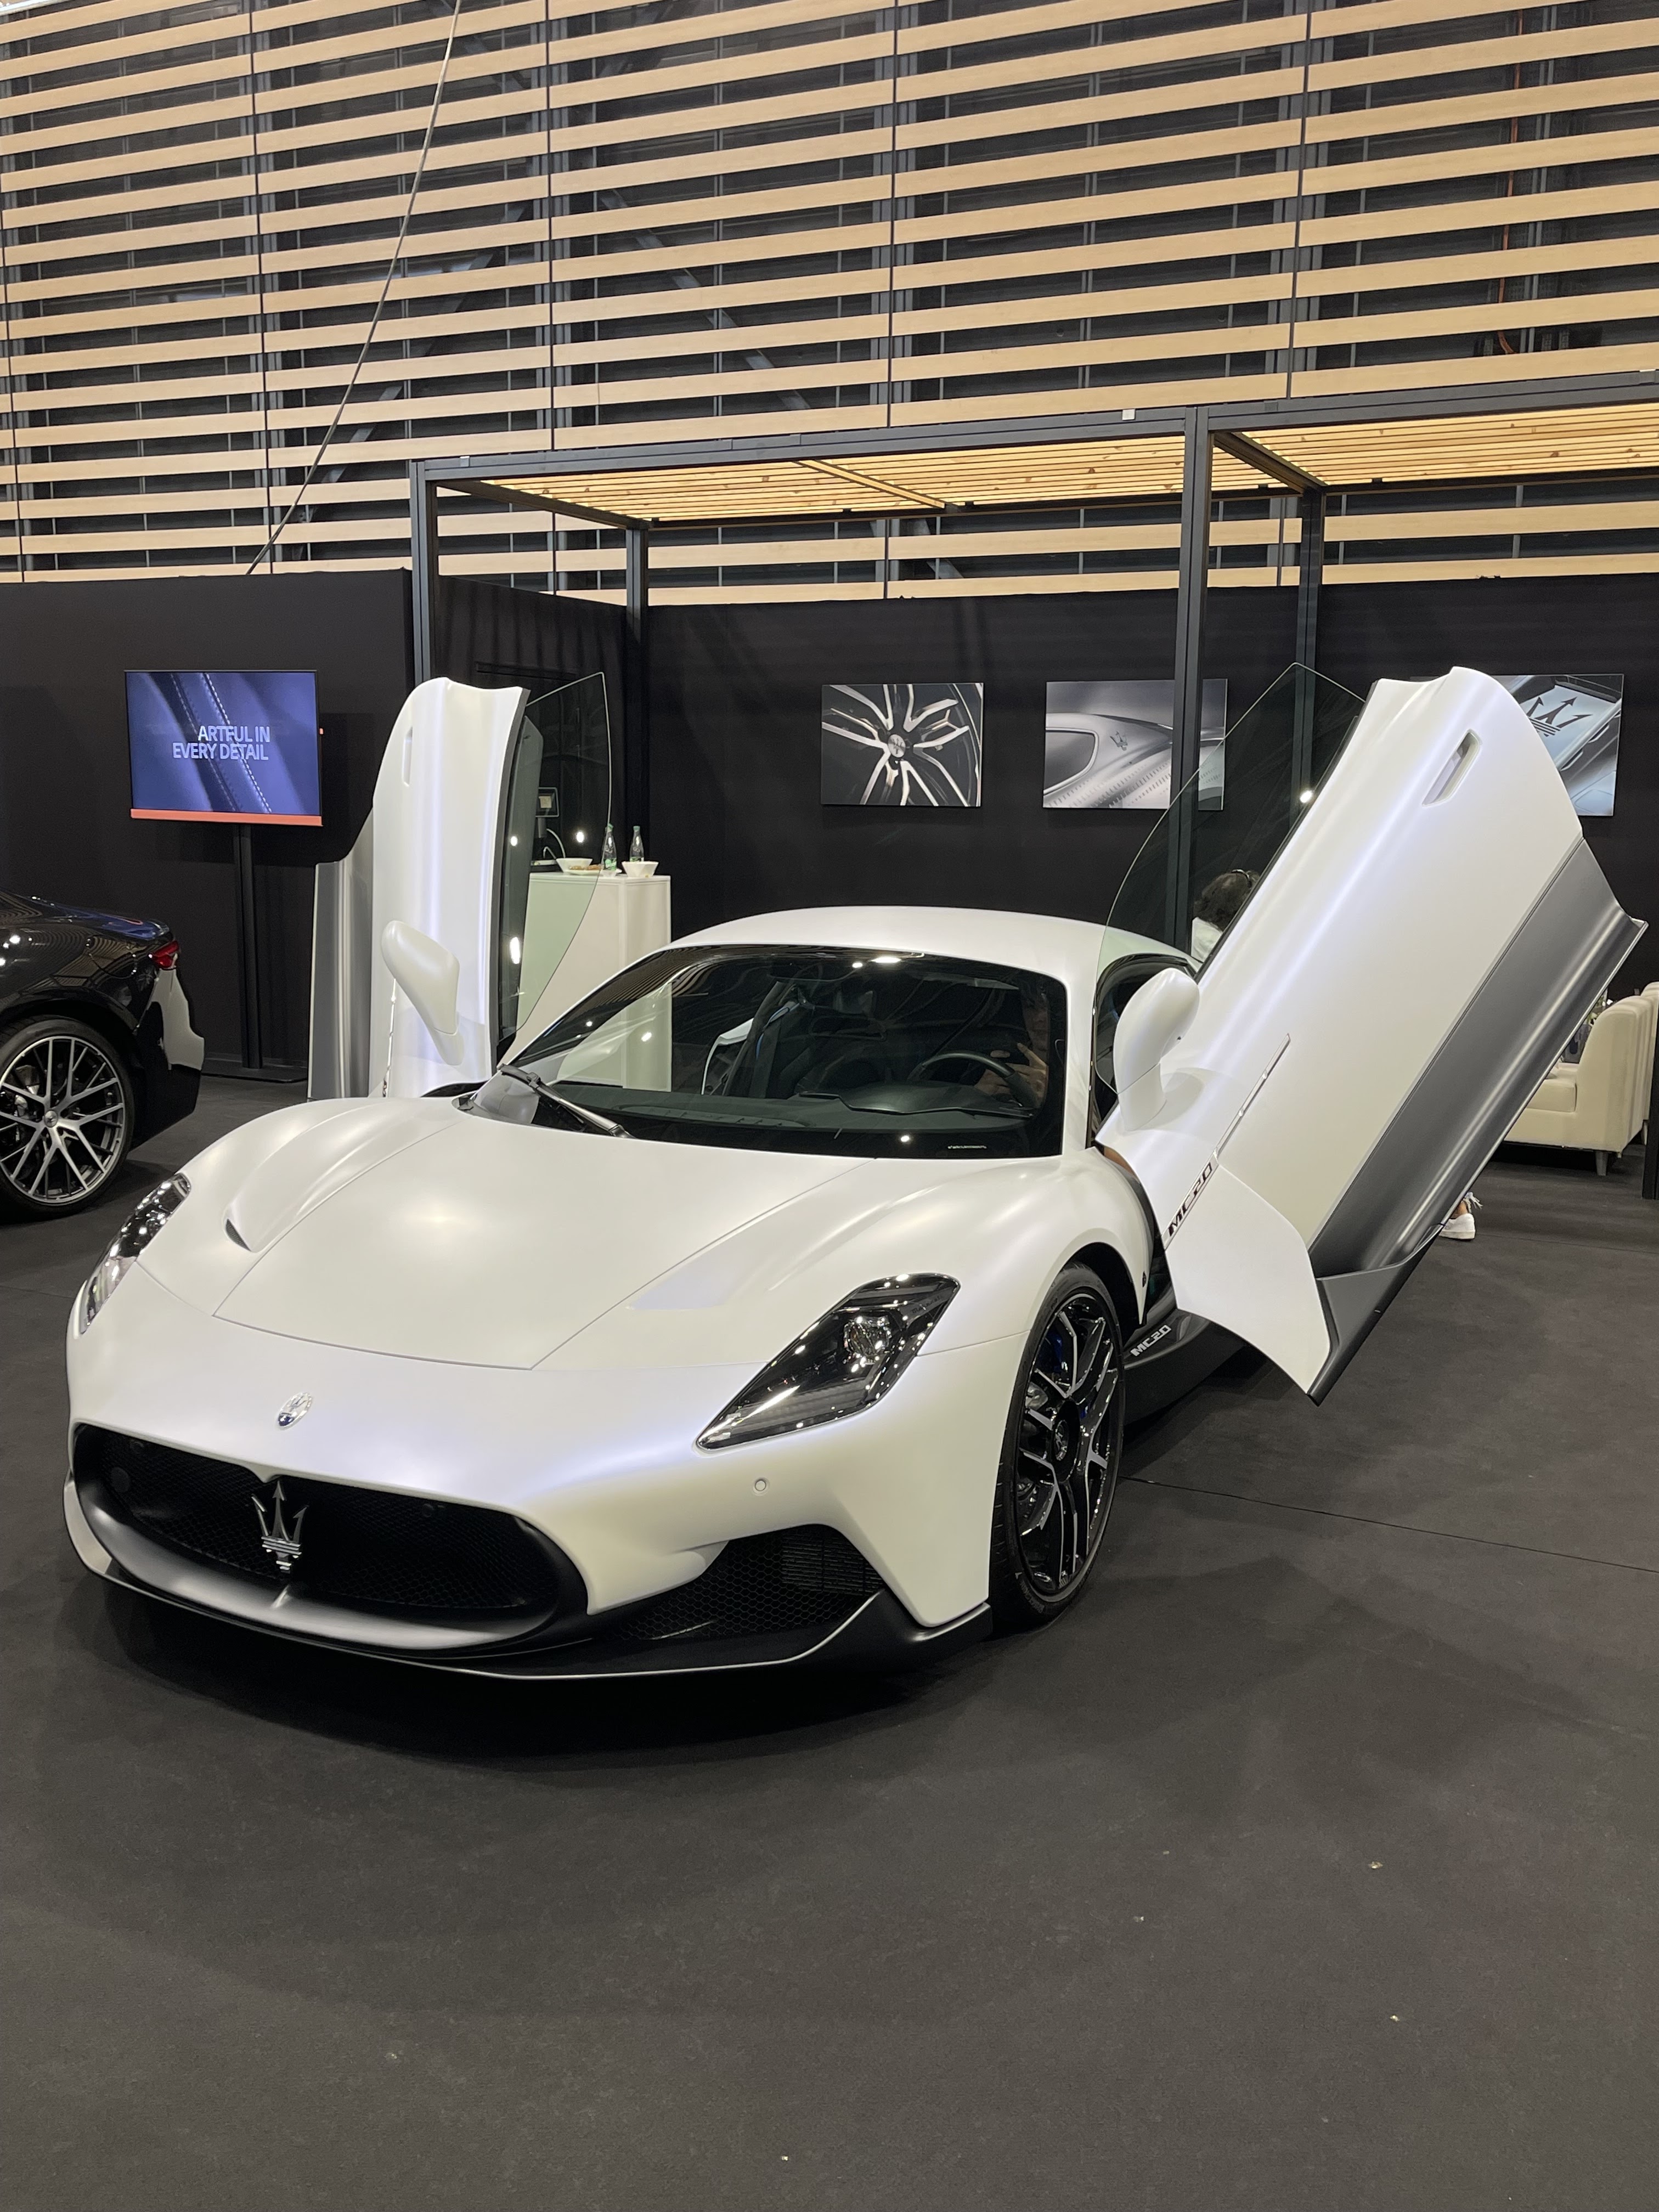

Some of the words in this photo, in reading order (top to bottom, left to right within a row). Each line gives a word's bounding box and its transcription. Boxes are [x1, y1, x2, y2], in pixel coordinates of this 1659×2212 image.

[198, 725, 253, 742] ARTFUL
[255, 726, 270, 743] IN
[172, 742, 217, 759] EVERY
[219, 743, 269, 760] DETAIL
[1168, 1162, 1213, 1237] MC20
[1130, 1324, 1172, 1357] MC20
